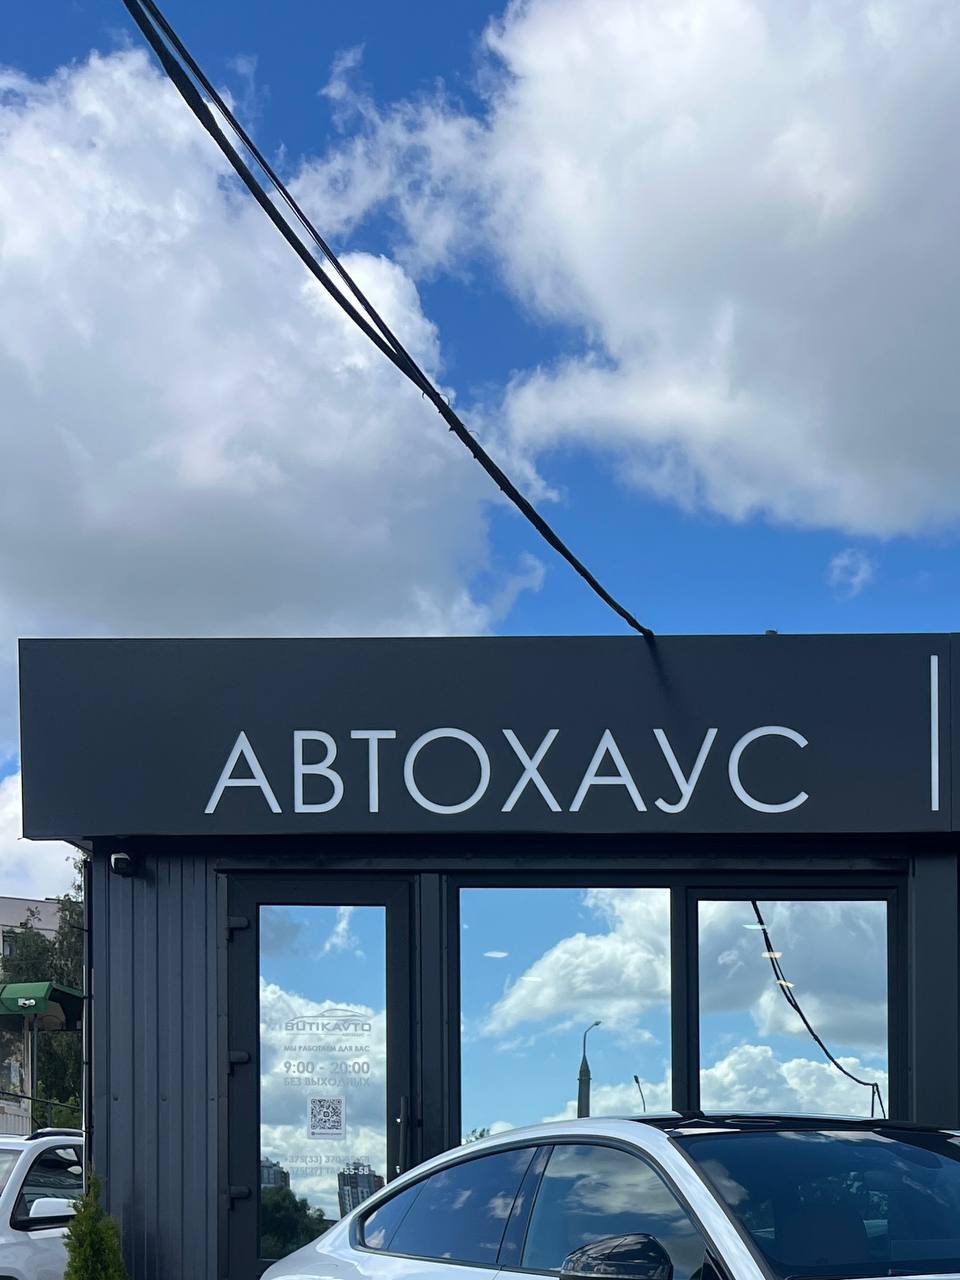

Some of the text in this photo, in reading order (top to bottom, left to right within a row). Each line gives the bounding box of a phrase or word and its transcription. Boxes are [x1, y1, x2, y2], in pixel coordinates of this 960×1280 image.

[204, 726, 809, 815] АВТОХАУС
[285, 1021, 372, 1032] BUTIKAVTO
[284, 1061, 315, 1074] 9:00
[329, 1061, 370, 1074] 20:00
[284, 1077, 301, 1087] БЕЗ
